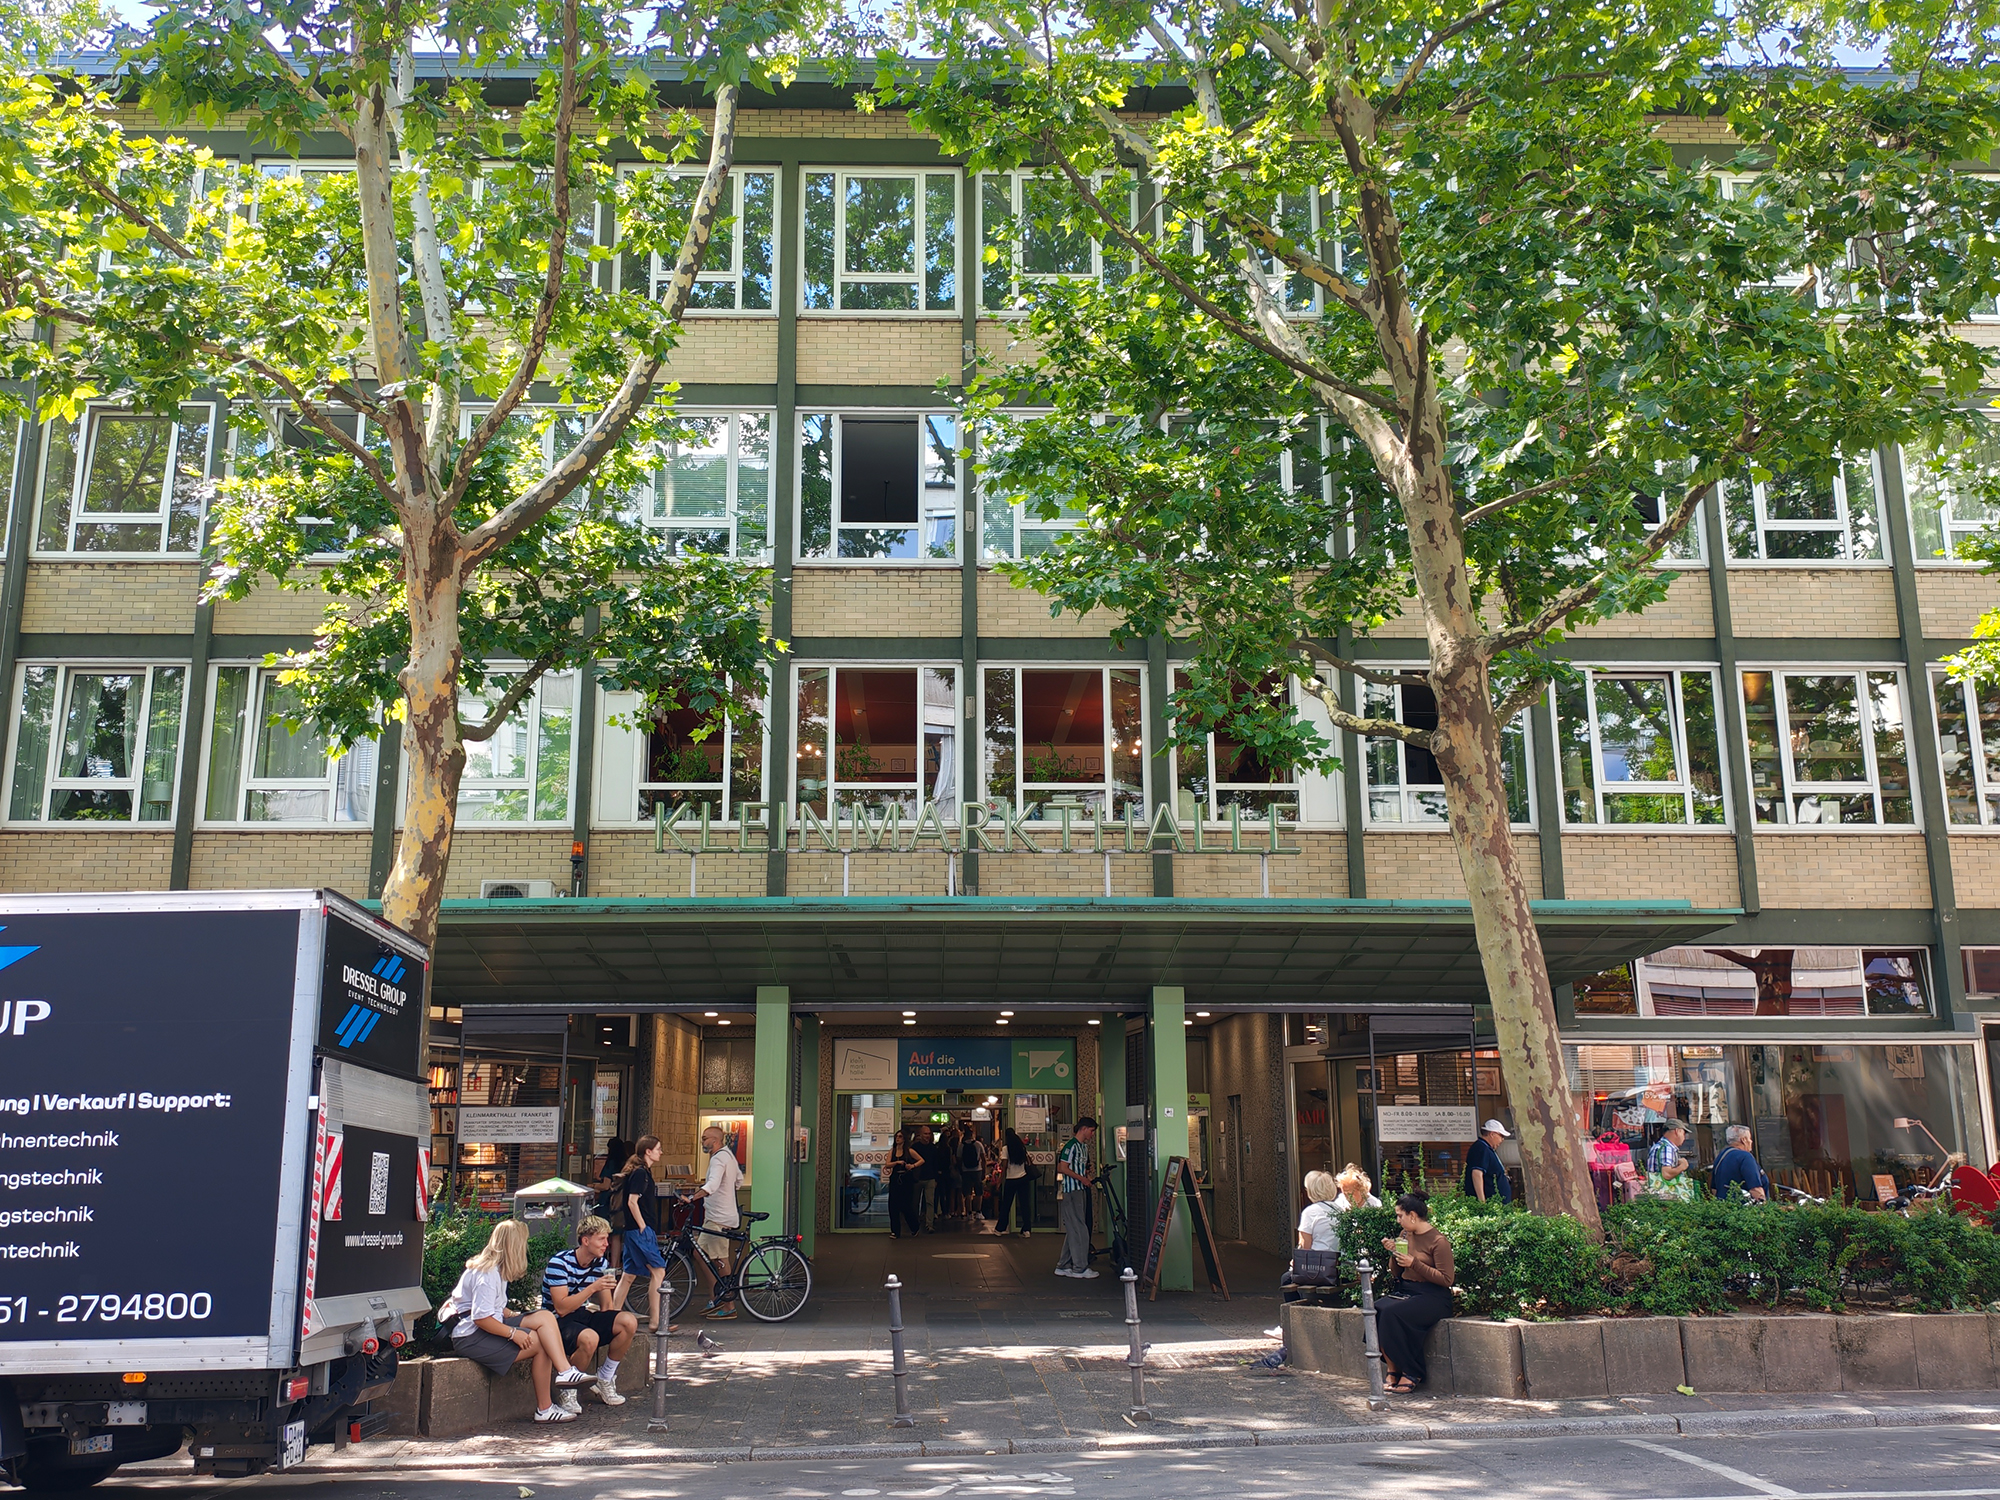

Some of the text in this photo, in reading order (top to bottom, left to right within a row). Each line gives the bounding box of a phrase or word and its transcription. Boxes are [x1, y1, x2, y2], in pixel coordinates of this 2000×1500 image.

[655, 801, 1301, 854] KLEINMARKTHALLE
[343, 965, 407, 1007] DRESSEL GROUP
[348, 990, 399, 1015] EVENT TECHNOLOGY
[0, 1000, 51, 1035] P
[909, 1051, 955, 1065] Auf die
[908, 1066, 1000, 1077] Kleinmarkthalle!
[43, 1093, 127, 1110] Verkauf
[138, 1092, 231, 1112] Support:
[0, 1131, 120, 1148] hnentechnik
[344, 1230, 404, 1250] www.dressel-group.de
[57, 1292, 212, 1323] 2794800
